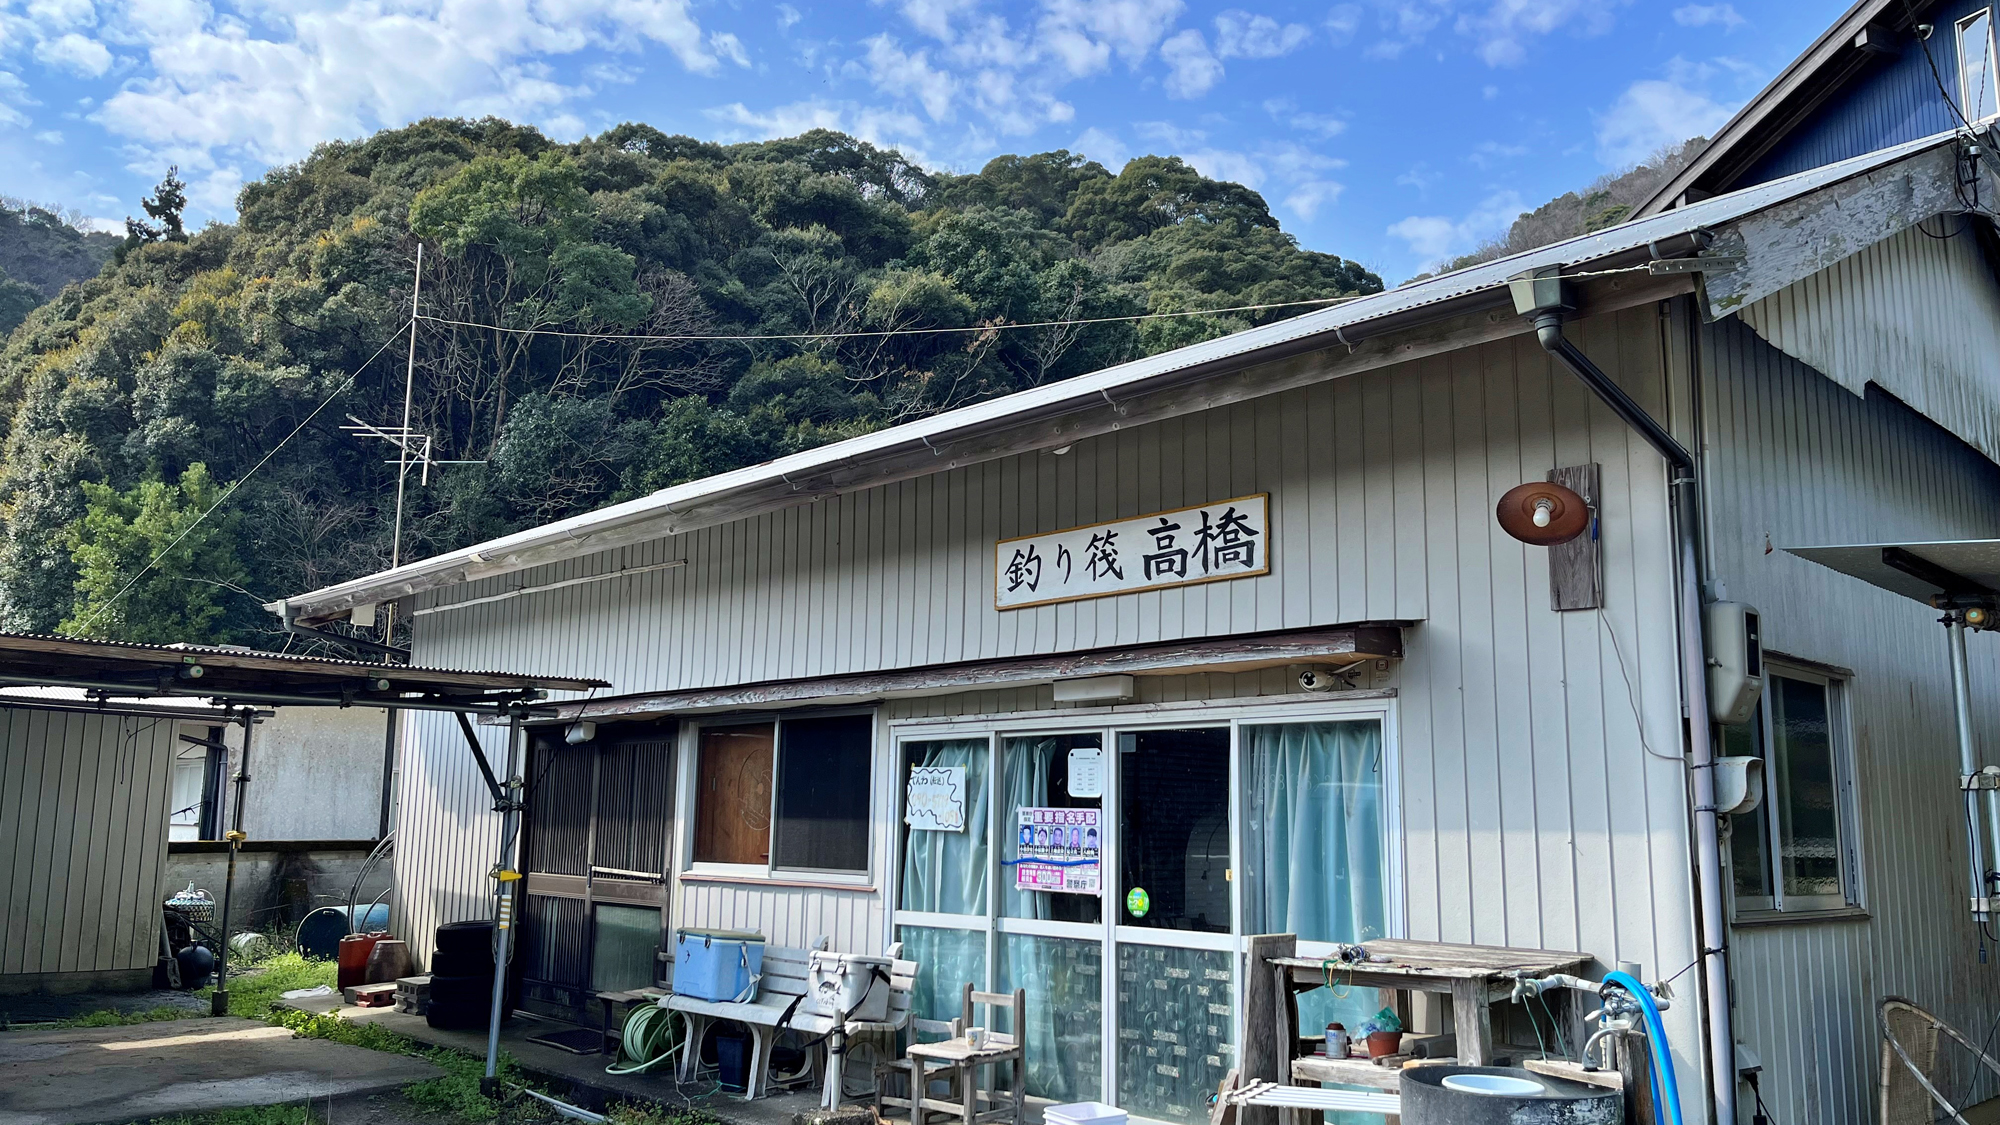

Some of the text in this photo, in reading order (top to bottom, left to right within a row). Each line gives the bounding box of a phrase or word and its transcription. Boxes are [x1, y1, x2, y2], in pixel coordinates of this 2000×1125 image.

[1033, 810, 1097, 826] 重要指名手配
